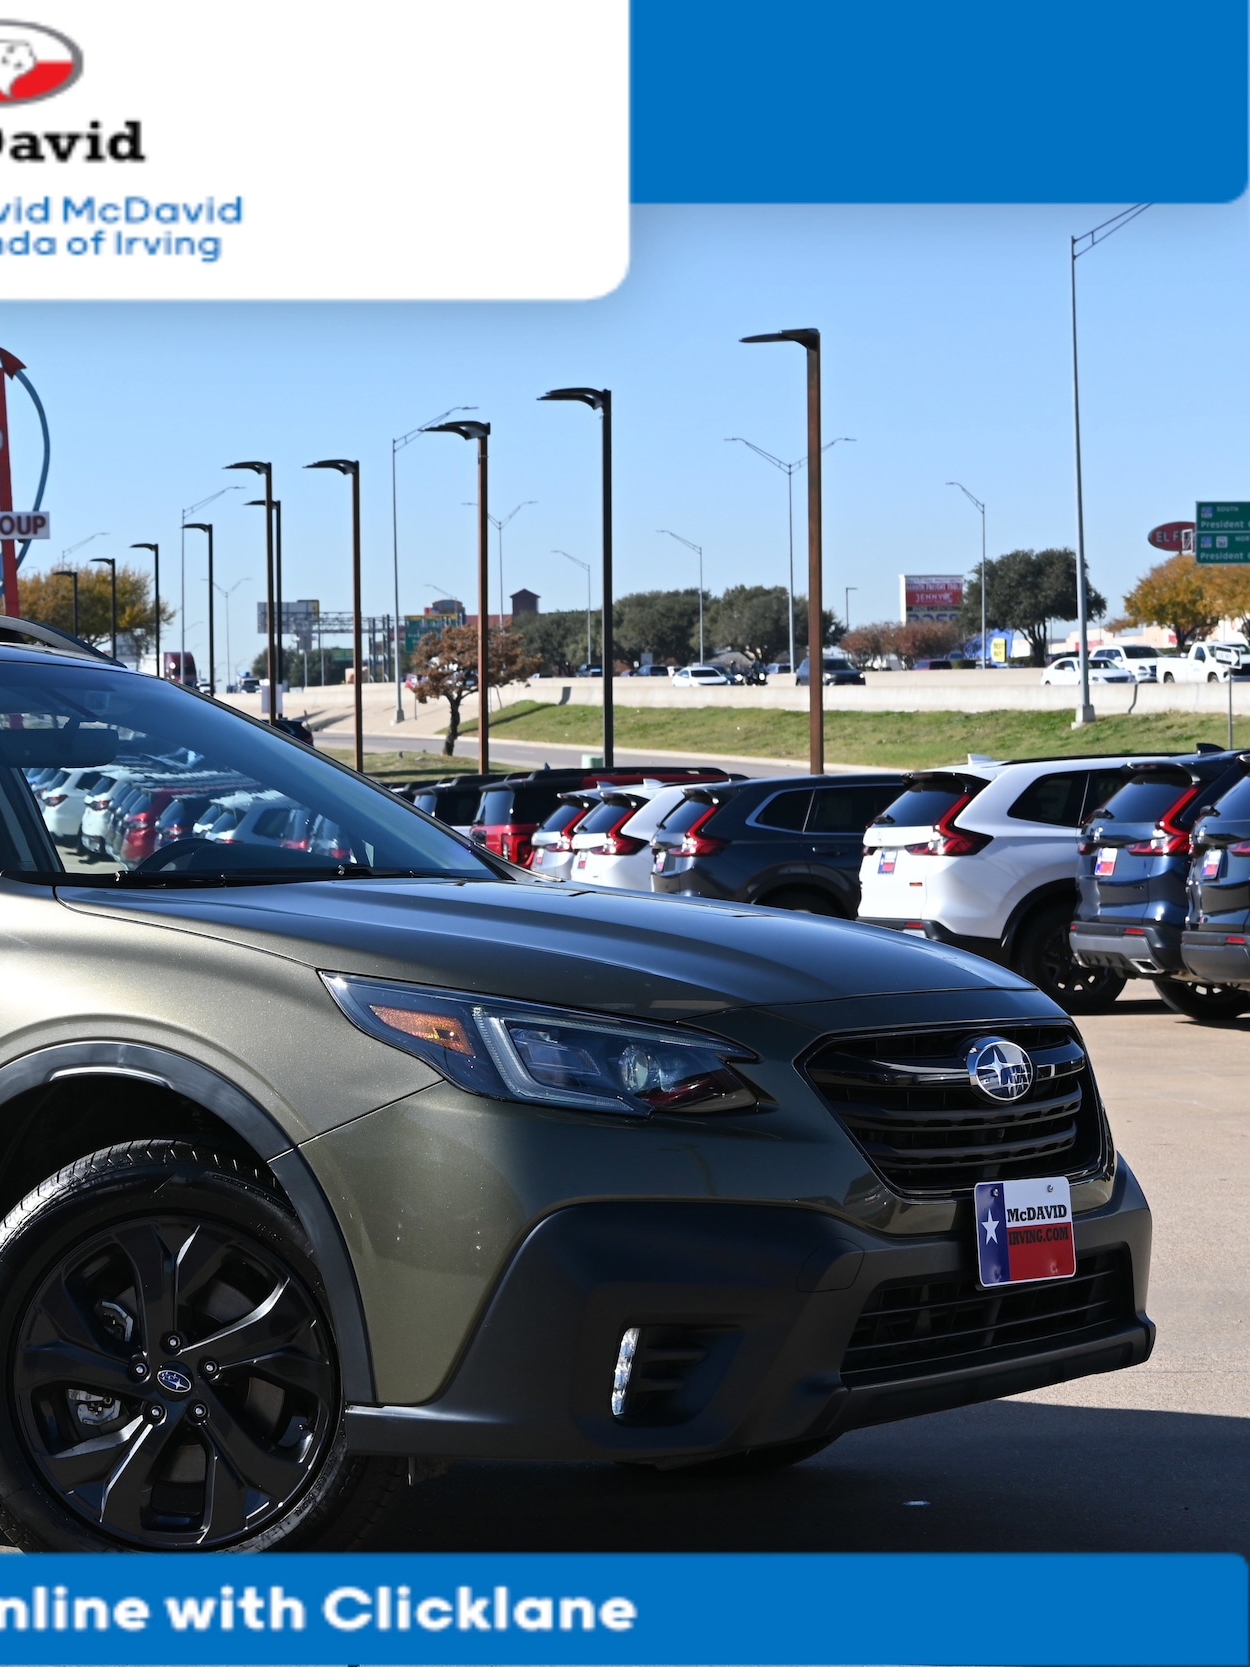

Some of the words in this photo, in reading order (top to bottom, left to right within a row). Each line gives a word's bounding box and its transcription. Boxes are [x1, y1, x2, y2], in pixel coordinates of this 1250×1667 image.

[1200, 520, 1244, 529] President
[1199, 552, 1244, 560] President
[1007, 1204, 1067, 1222] McDAVID
[1009, 1227, 1068, 1245] IRVING.COM
